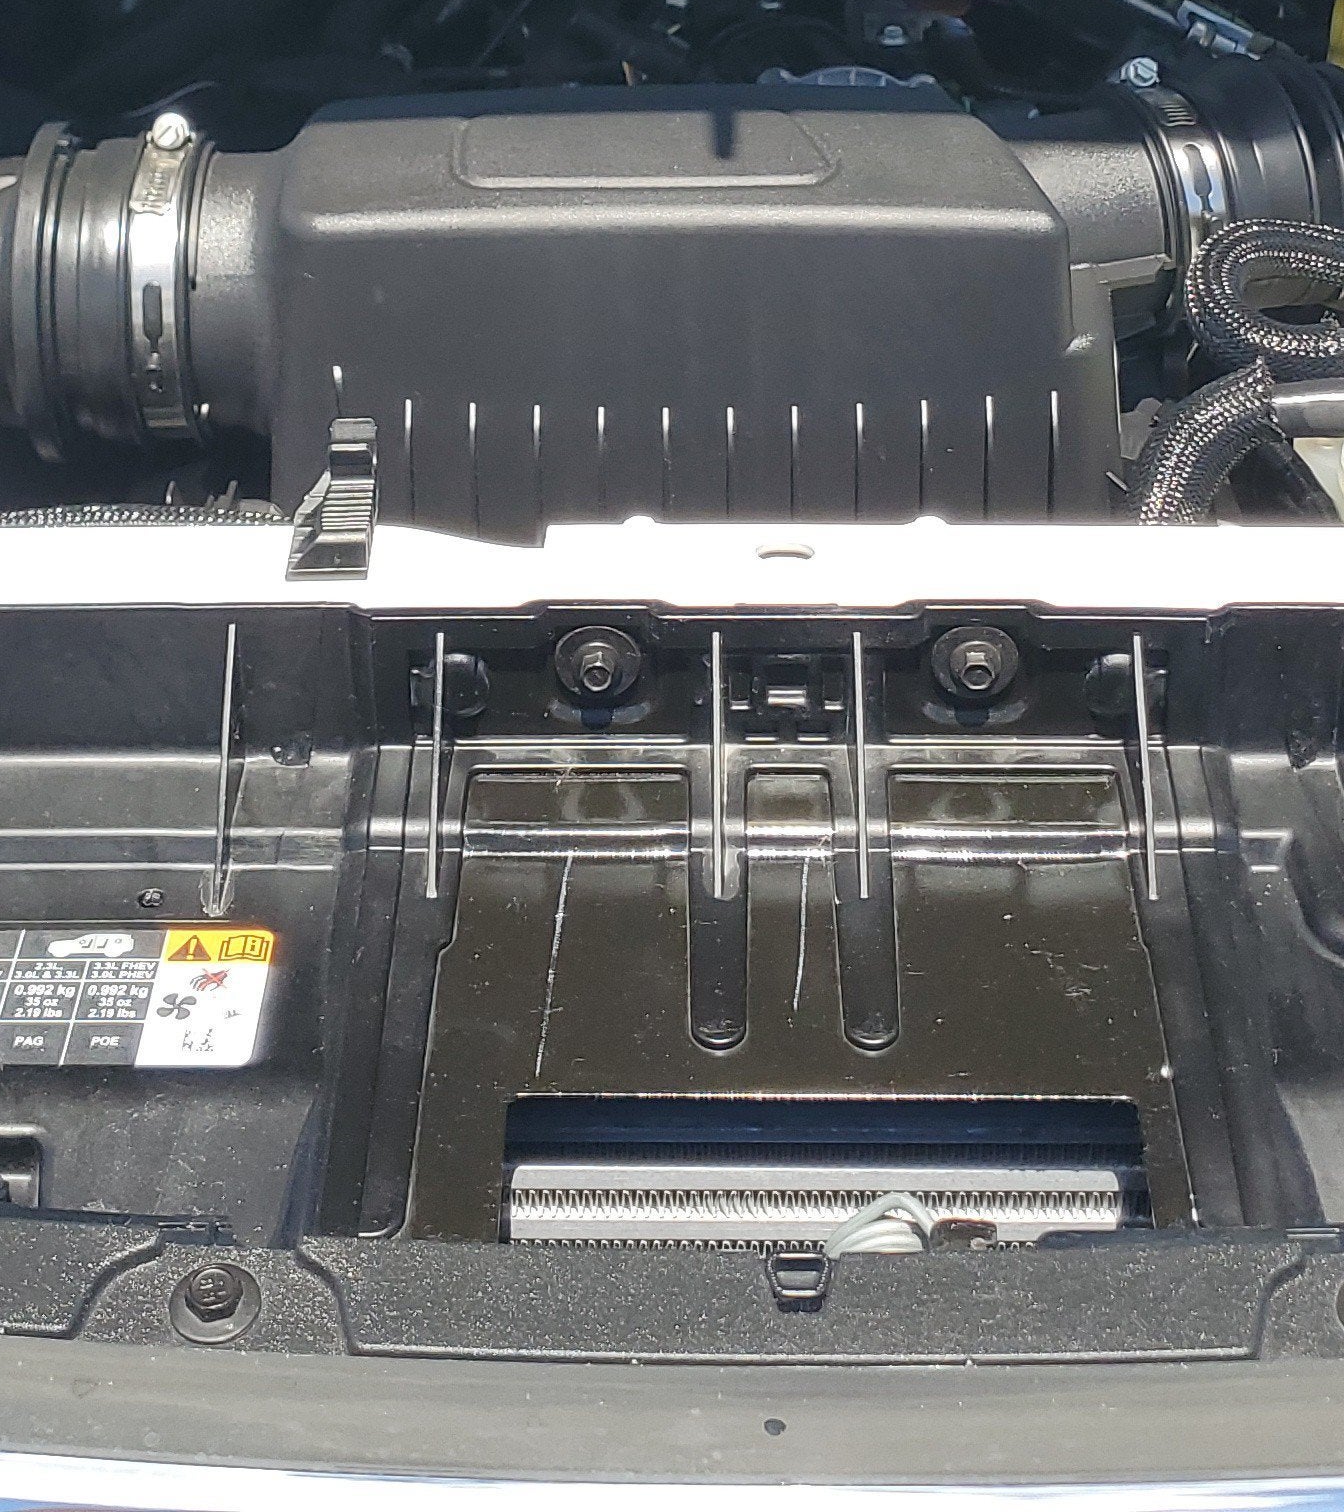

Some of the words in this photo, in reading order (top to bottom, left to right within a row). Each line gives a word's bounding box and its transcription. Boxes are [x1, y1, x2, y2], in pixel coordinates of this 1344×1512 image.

[93, 962, 119, 970] 3.3L
[121, 962, 157, 970] FHEV
[14, 970, 39, 978] 3.0L
[42, 970, 52, 978] &
[55, 970, 80, 978] 3.3L
[118, 970, 155, 978] PHEV
[14, 984, 55, 996] 0.992
[56, 984, 76, 998] kg
[87, 984, 127, 996] 0.992
[130, 984, 149, 998] kg
[24, 996, 42, 1007] 35
[43, 998, 59, 1007] oz
[98, 996, 114, 1007] 35
[116, 998, 133, 1007] oz
[14, 1007, 42, 1018] 2.19
[42, 1007, 63, 1018] lbs
[87, 1007, 115, 1018] 2.19
[116, 1007, 137, 1018] lbs
[14, 1035, 44, 1046] PAG
[91, 1035, 120, 1046] POE
